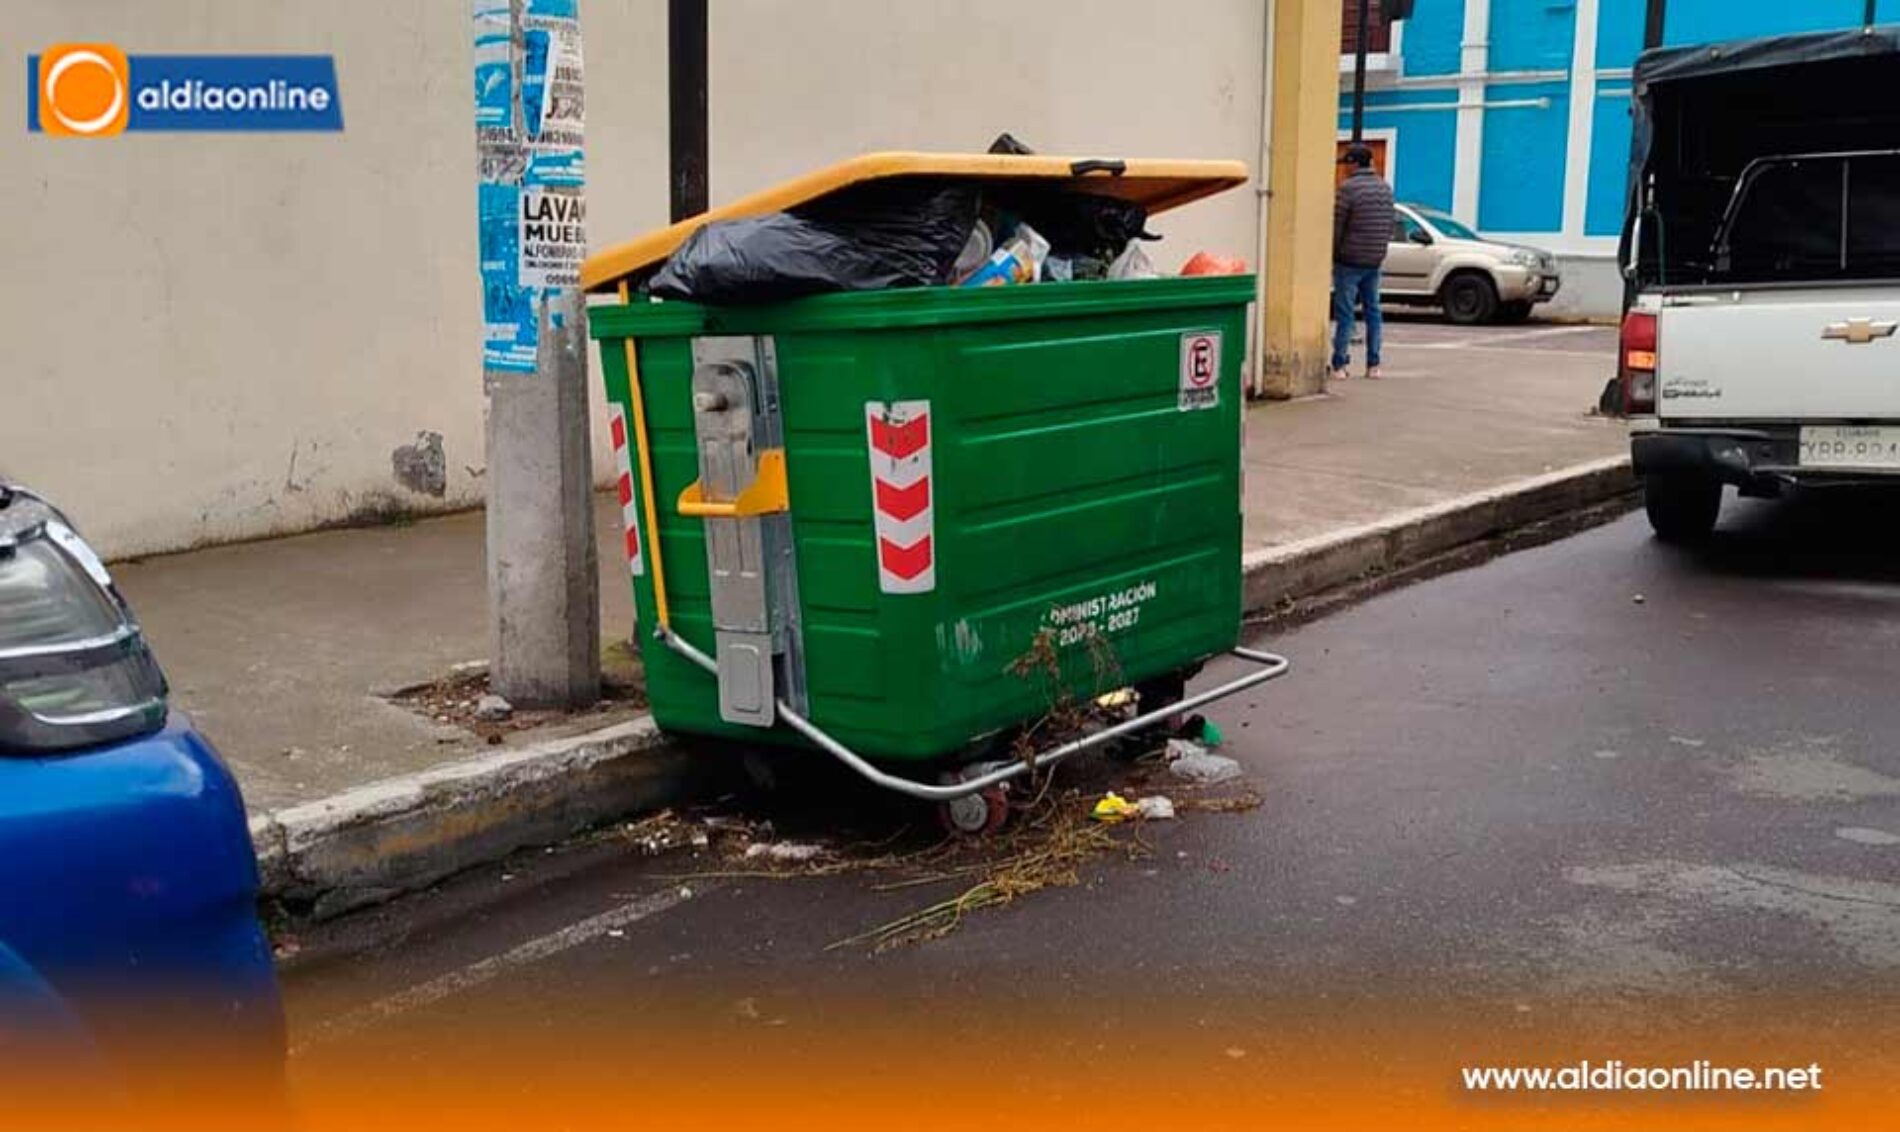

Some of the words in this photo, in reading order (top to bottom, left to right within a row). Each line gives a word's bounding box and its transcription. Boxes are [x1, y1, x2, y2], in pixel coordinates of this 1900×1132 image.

[524, 195, 586, 222] LAVA
[1041, 580, 1157, 627] DMINISTRACIÓN
[1108, 607, 1140, 632] 2027
